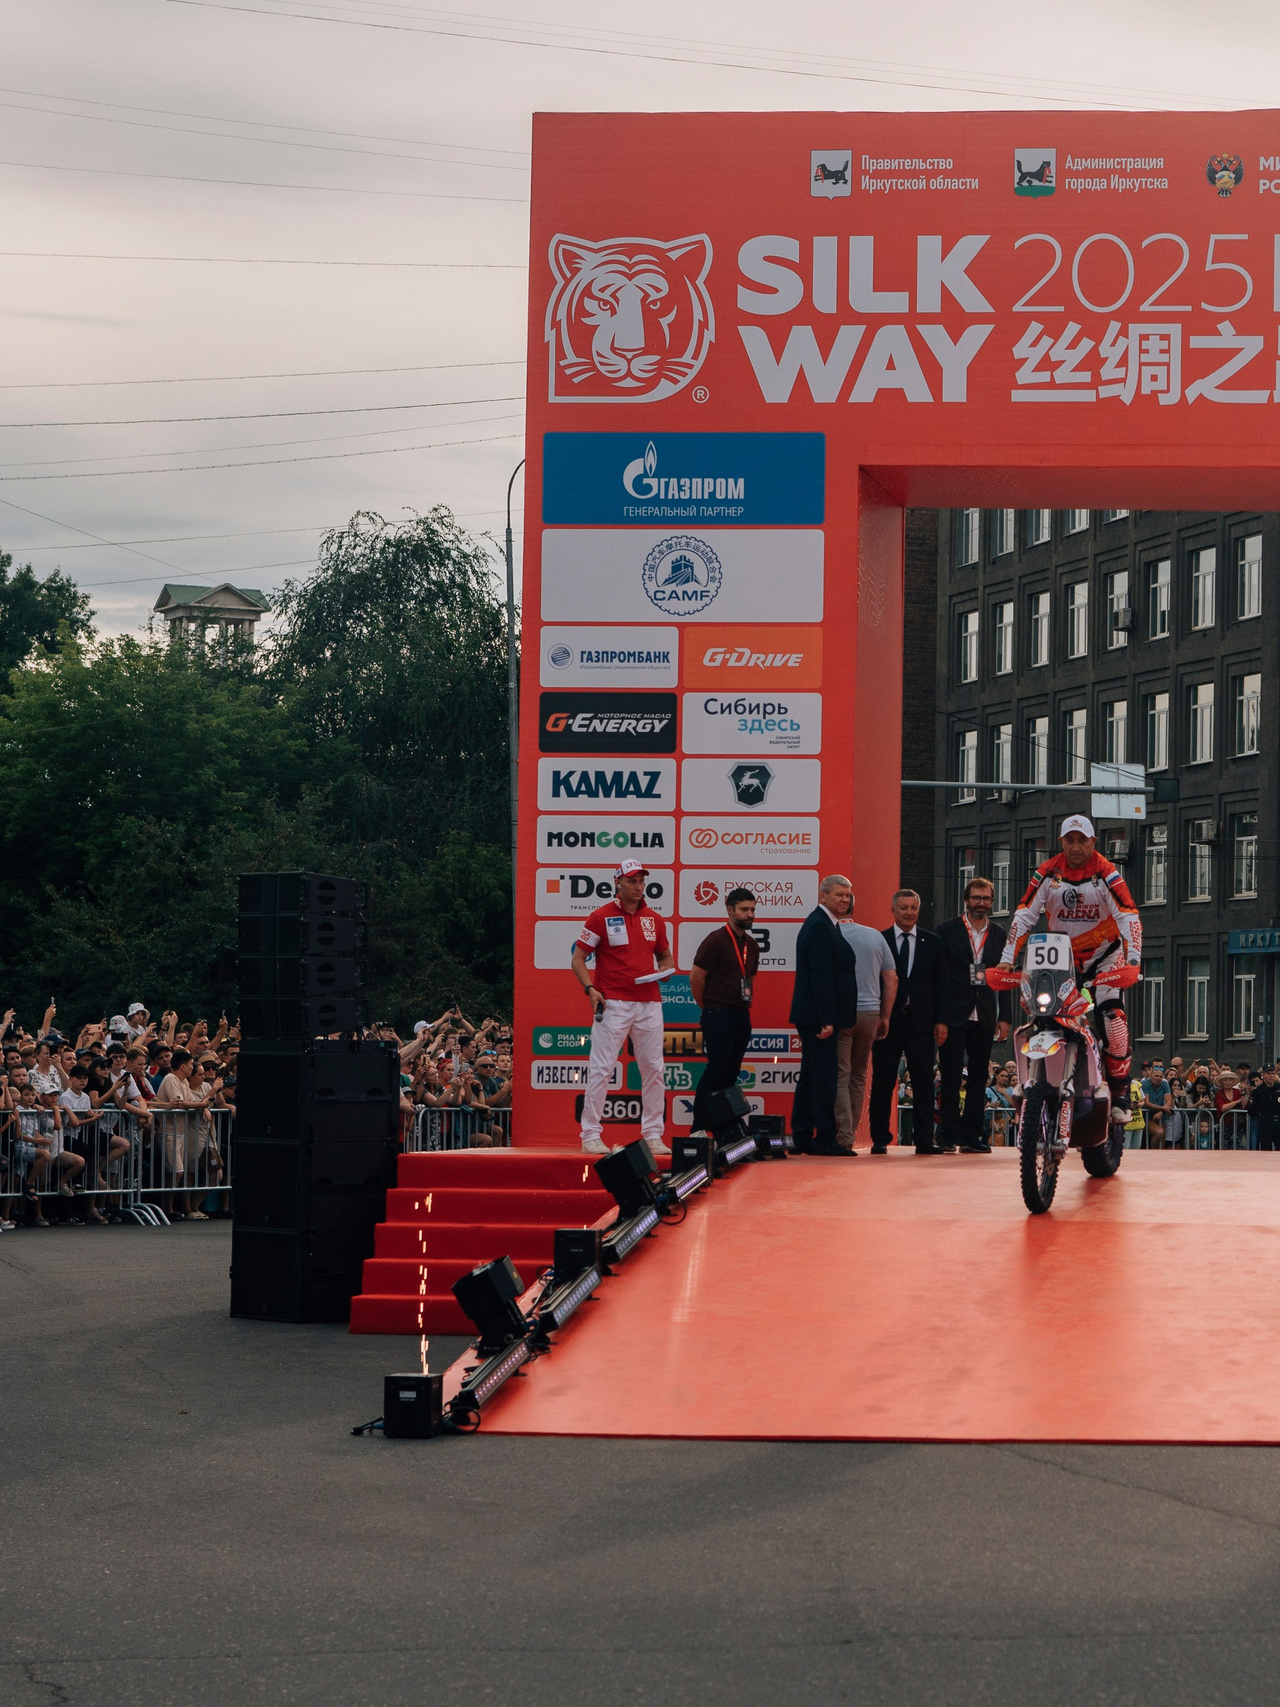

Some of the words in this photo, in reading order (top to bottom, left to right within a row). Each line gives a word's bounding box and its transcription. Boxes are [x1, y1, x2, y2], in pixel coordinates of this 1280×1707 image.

[861, 154, 954, 173] Правительство
[1065, 154, 1165, 171] Администрация
[861, 174, 927, 194] Иркутской
[929, 173, 980, 191] области
[1065, 176, 1108, 193] города
[1110, 174, 1169, 193] Иркутска
[737, 234, 996, 316] SILK
[1011, 233, 1254, 313] 2025
[737, 324, 996, 404] WAY
[658, 477, 745, 500] ГАЗПРОМ
[623, 504, 697, 517] ГЕНЕРАЛЬНЫЙ
[699, 506, 744, 517] ПАРТНЕР
[653, 590, 712, 602] CAMF
[580, 650, 671, 664] ГАЗПРОМБАНК
[704, 697, 789, 719] Сибирь
[737, 717, 801, 735] здесь
[552, 770, 662, 799] KAMAZ
[547, 830, 665, 849] MONGOLIA
[721, 832, 812, 845] СОГЛАСИЕ
[760, 847, 812, 855] страхование
[569, 874, 664, 900] Deo
[724, 881, 793, 893] РУССКАЯ
[1057, 909, 1100, 920] ARENA
[1035, 946, 1058, 966] 50
[602, 1100, 640, 1119] 360
[1060, 1100, 1071, 1136] NAIKOM
